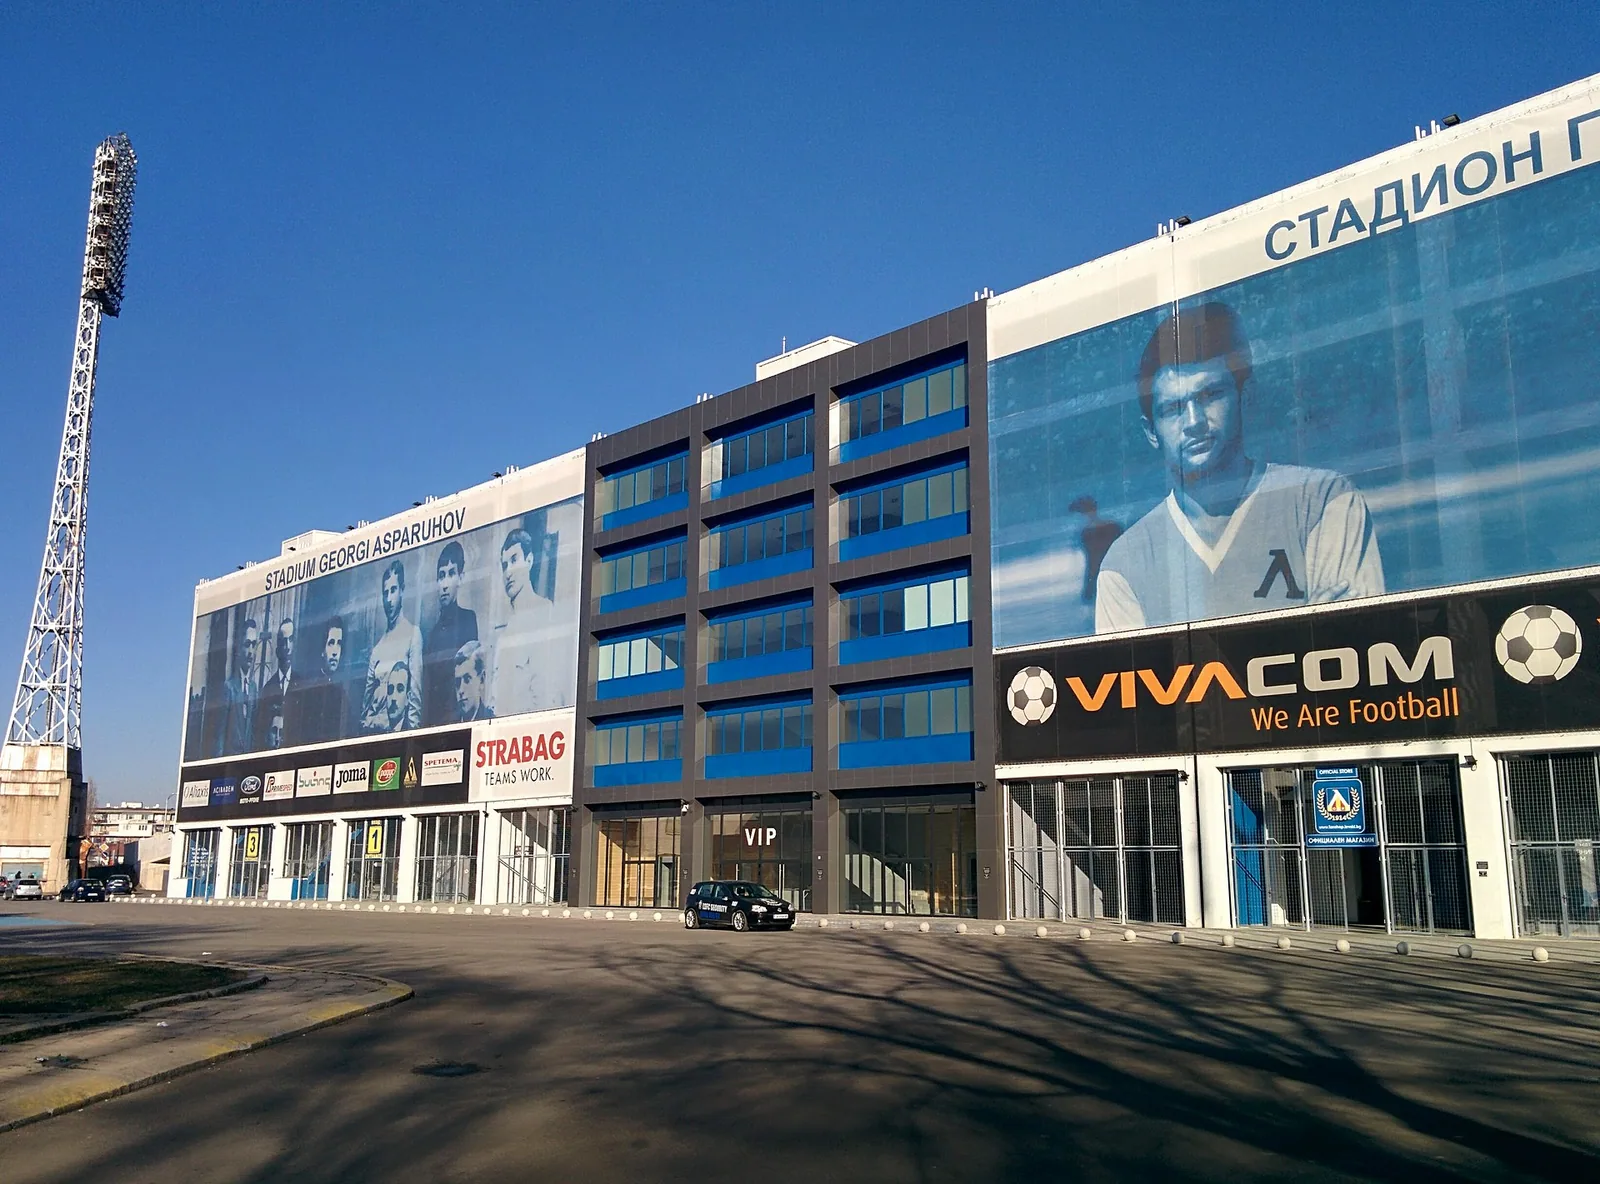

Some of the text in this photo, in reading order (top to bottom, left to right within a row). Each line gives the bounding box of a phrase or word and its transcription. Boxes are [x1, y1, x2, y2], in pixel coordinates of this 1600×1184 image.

[1264, 130, 1543, 261] СТАДИОН
[265, 507, 466, 591] STADIUM GEORGI ASPARUHOV
[1065, 635, 1454, 712] VIVACOM
[1250, 687, 1460, 731] We Are Football
[424, 757, 458, 767] SPETEMA
[475, 731, 566, 768] STRABAG
[485, 766, 554, 786] TEAMS WORK.
[250, 836, 256, 853] 3
[372, 829, 378, 850] 1
[744, 827, 777, 846] VIP
